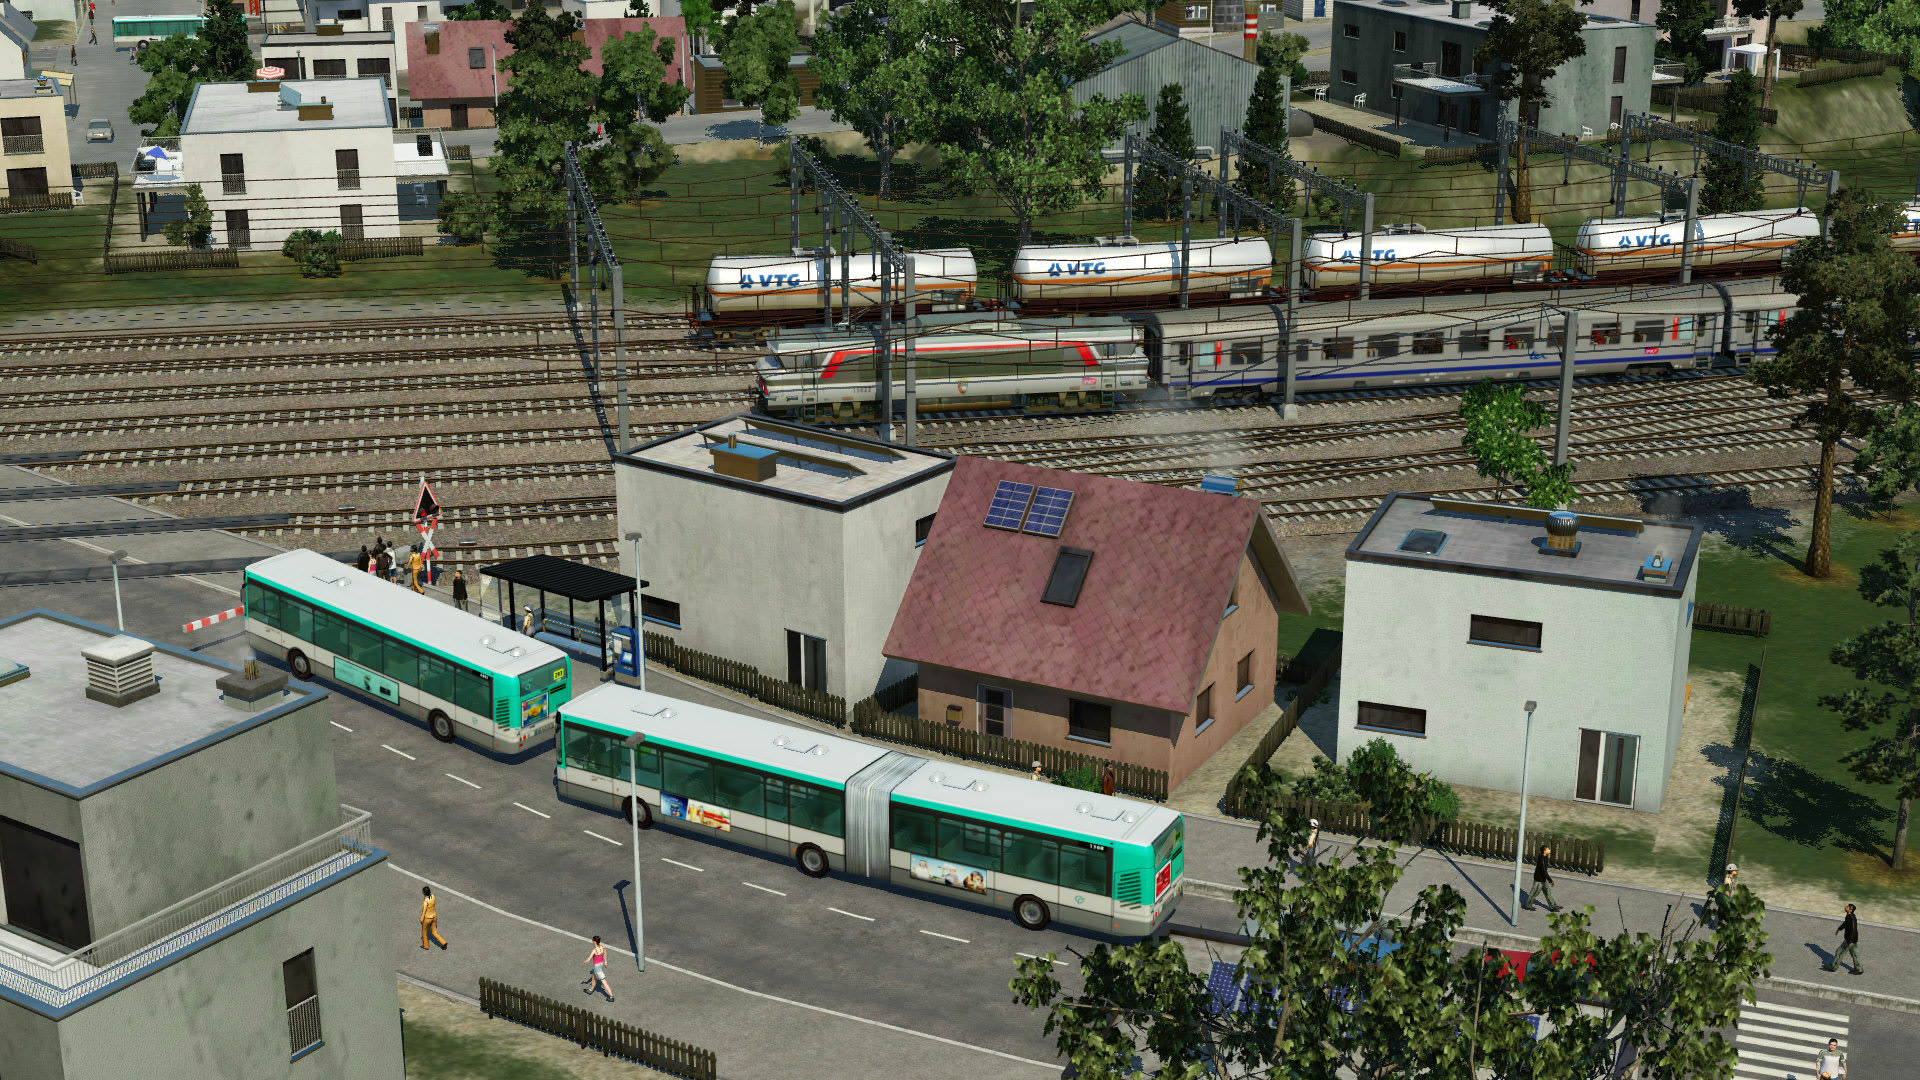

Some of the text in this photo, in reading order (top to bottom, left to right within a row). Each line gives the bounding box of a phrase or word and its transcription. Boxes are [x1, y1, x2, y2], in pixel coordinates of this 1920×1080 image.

[1635, 234, 1671, 247] VTG
[1359, 249, 1396, 261] TG
[1067, 262, 1106, 275] VTG
[759, 273, 801, 287] VTG
